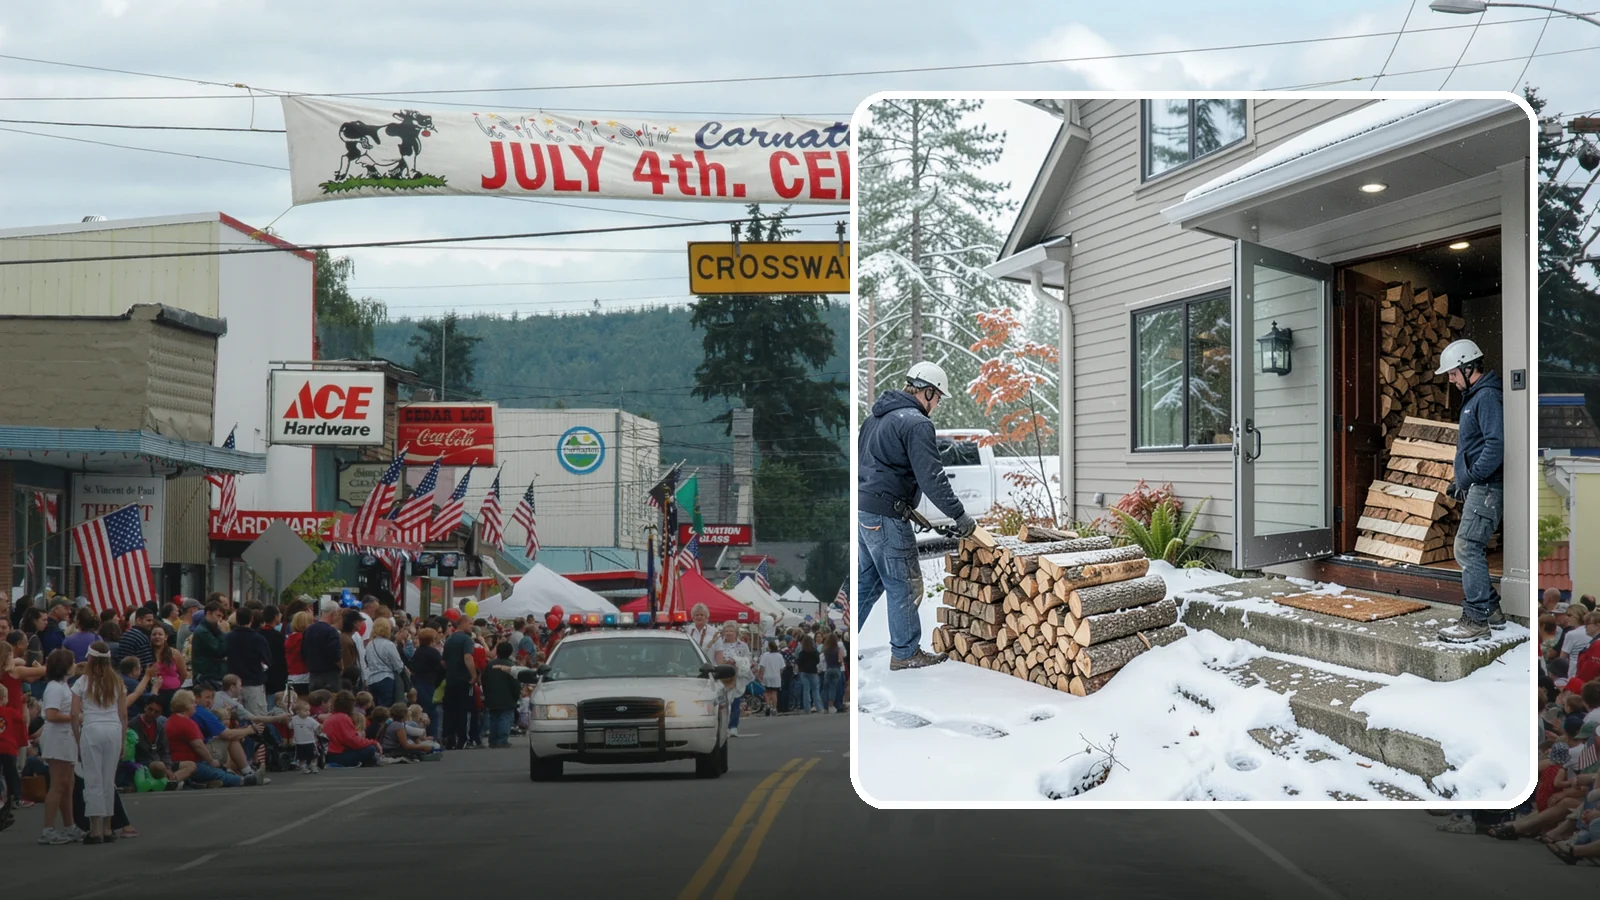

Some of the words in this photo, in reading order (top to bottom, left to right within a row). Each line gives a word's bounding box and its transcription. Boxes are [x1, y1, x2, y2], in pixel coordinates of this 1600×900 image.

[481, 140, 605, 193] JULY
[632, 149, 746, 198] 4th.
[697, 254, 850, 280] CROSSWA
[282, 380, 373, 420] ACE
[405, 409, 452, 422] CEDAR
[461, 409, 485, 421] LOG
[283, 421, 371, 436] Hardware
[416, 428, 477, 447] Coca-Cola
[83, 484, 93, 494] St.
[96, 485, 124, 495] Vincent
[126, 486, 136, 495] de
[137, 486, 155, 495] Paul
[688, 526, 742, 535] CRNATION
[699, 535, 730, 543] GLASS
